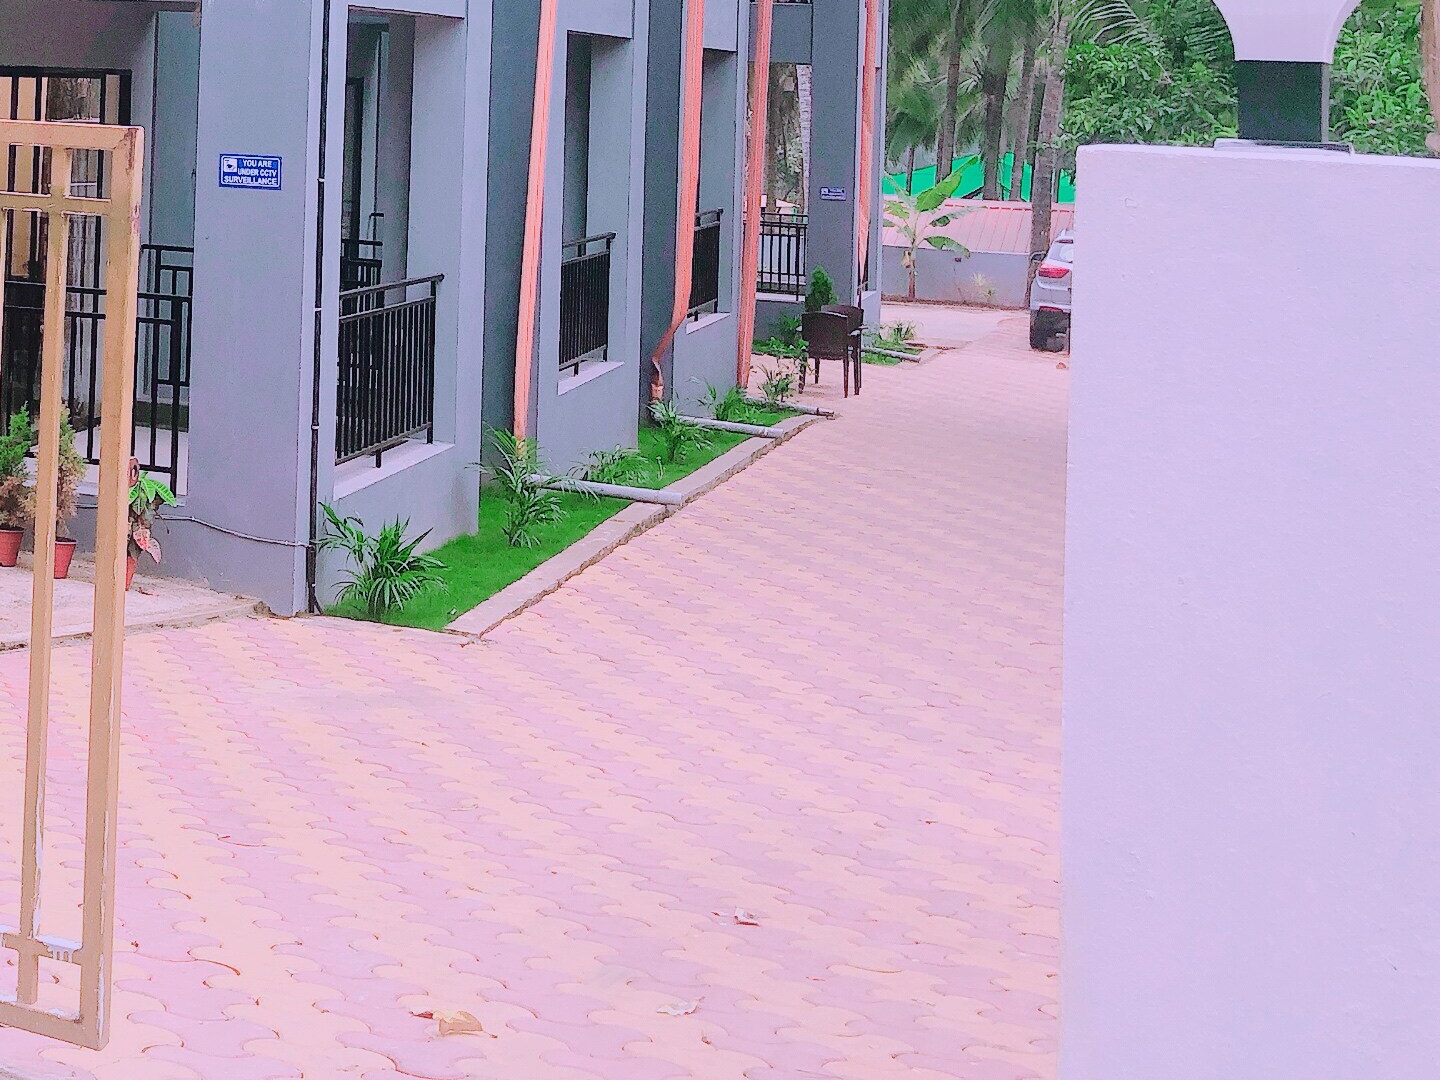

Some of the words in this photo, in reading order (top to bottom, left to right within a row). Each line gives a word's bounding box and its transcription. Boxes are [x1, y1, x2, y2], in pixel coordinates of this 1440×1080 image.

[243, 159, 257, 168] YOU
[258, 160, 272, 168] ARE
[237, 168, 259, 176] UNDER
[260, 169, 277, 177] CCTV
[223, 176, 278, 185] SURVEILLANCE
